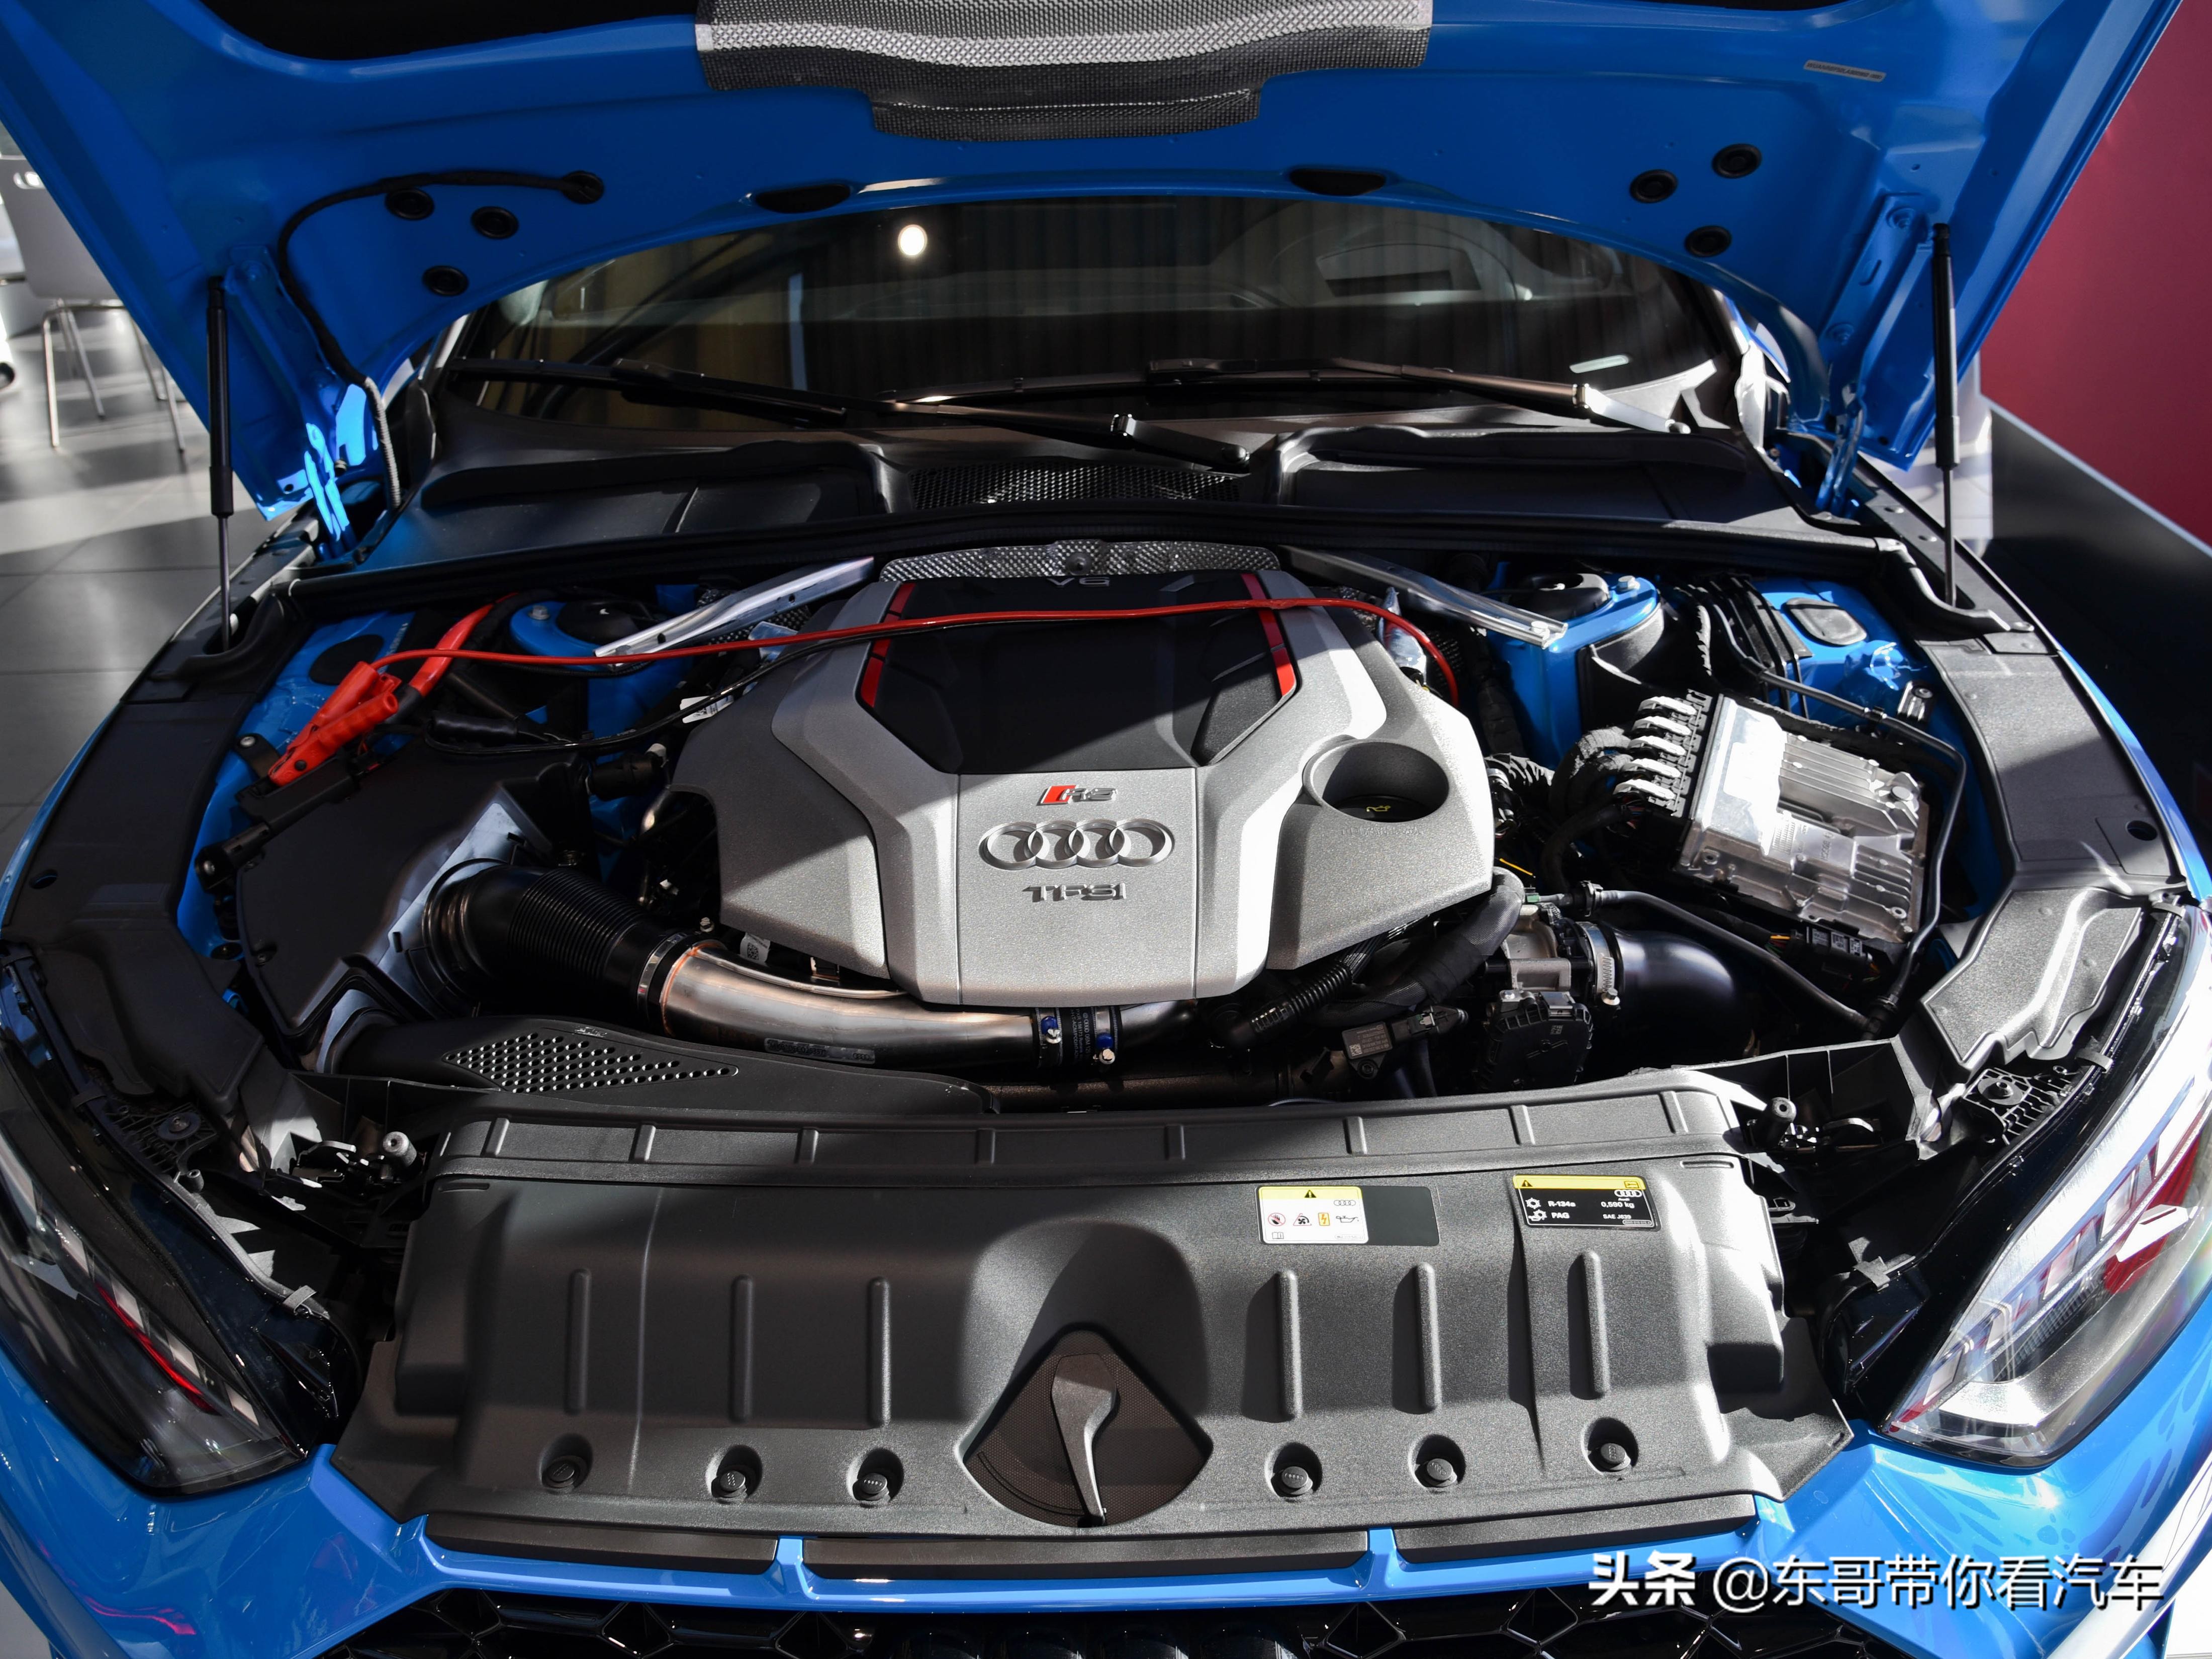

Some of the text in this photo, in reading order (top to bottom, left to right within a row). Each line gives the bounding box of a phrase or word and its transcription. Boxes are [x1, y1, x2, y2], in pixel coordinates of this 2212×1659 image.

[1046, 577, 1110, 587] V6
[1055, 786, 1119, 804] RS
[1024, 882, 1127, 903] TFSI
